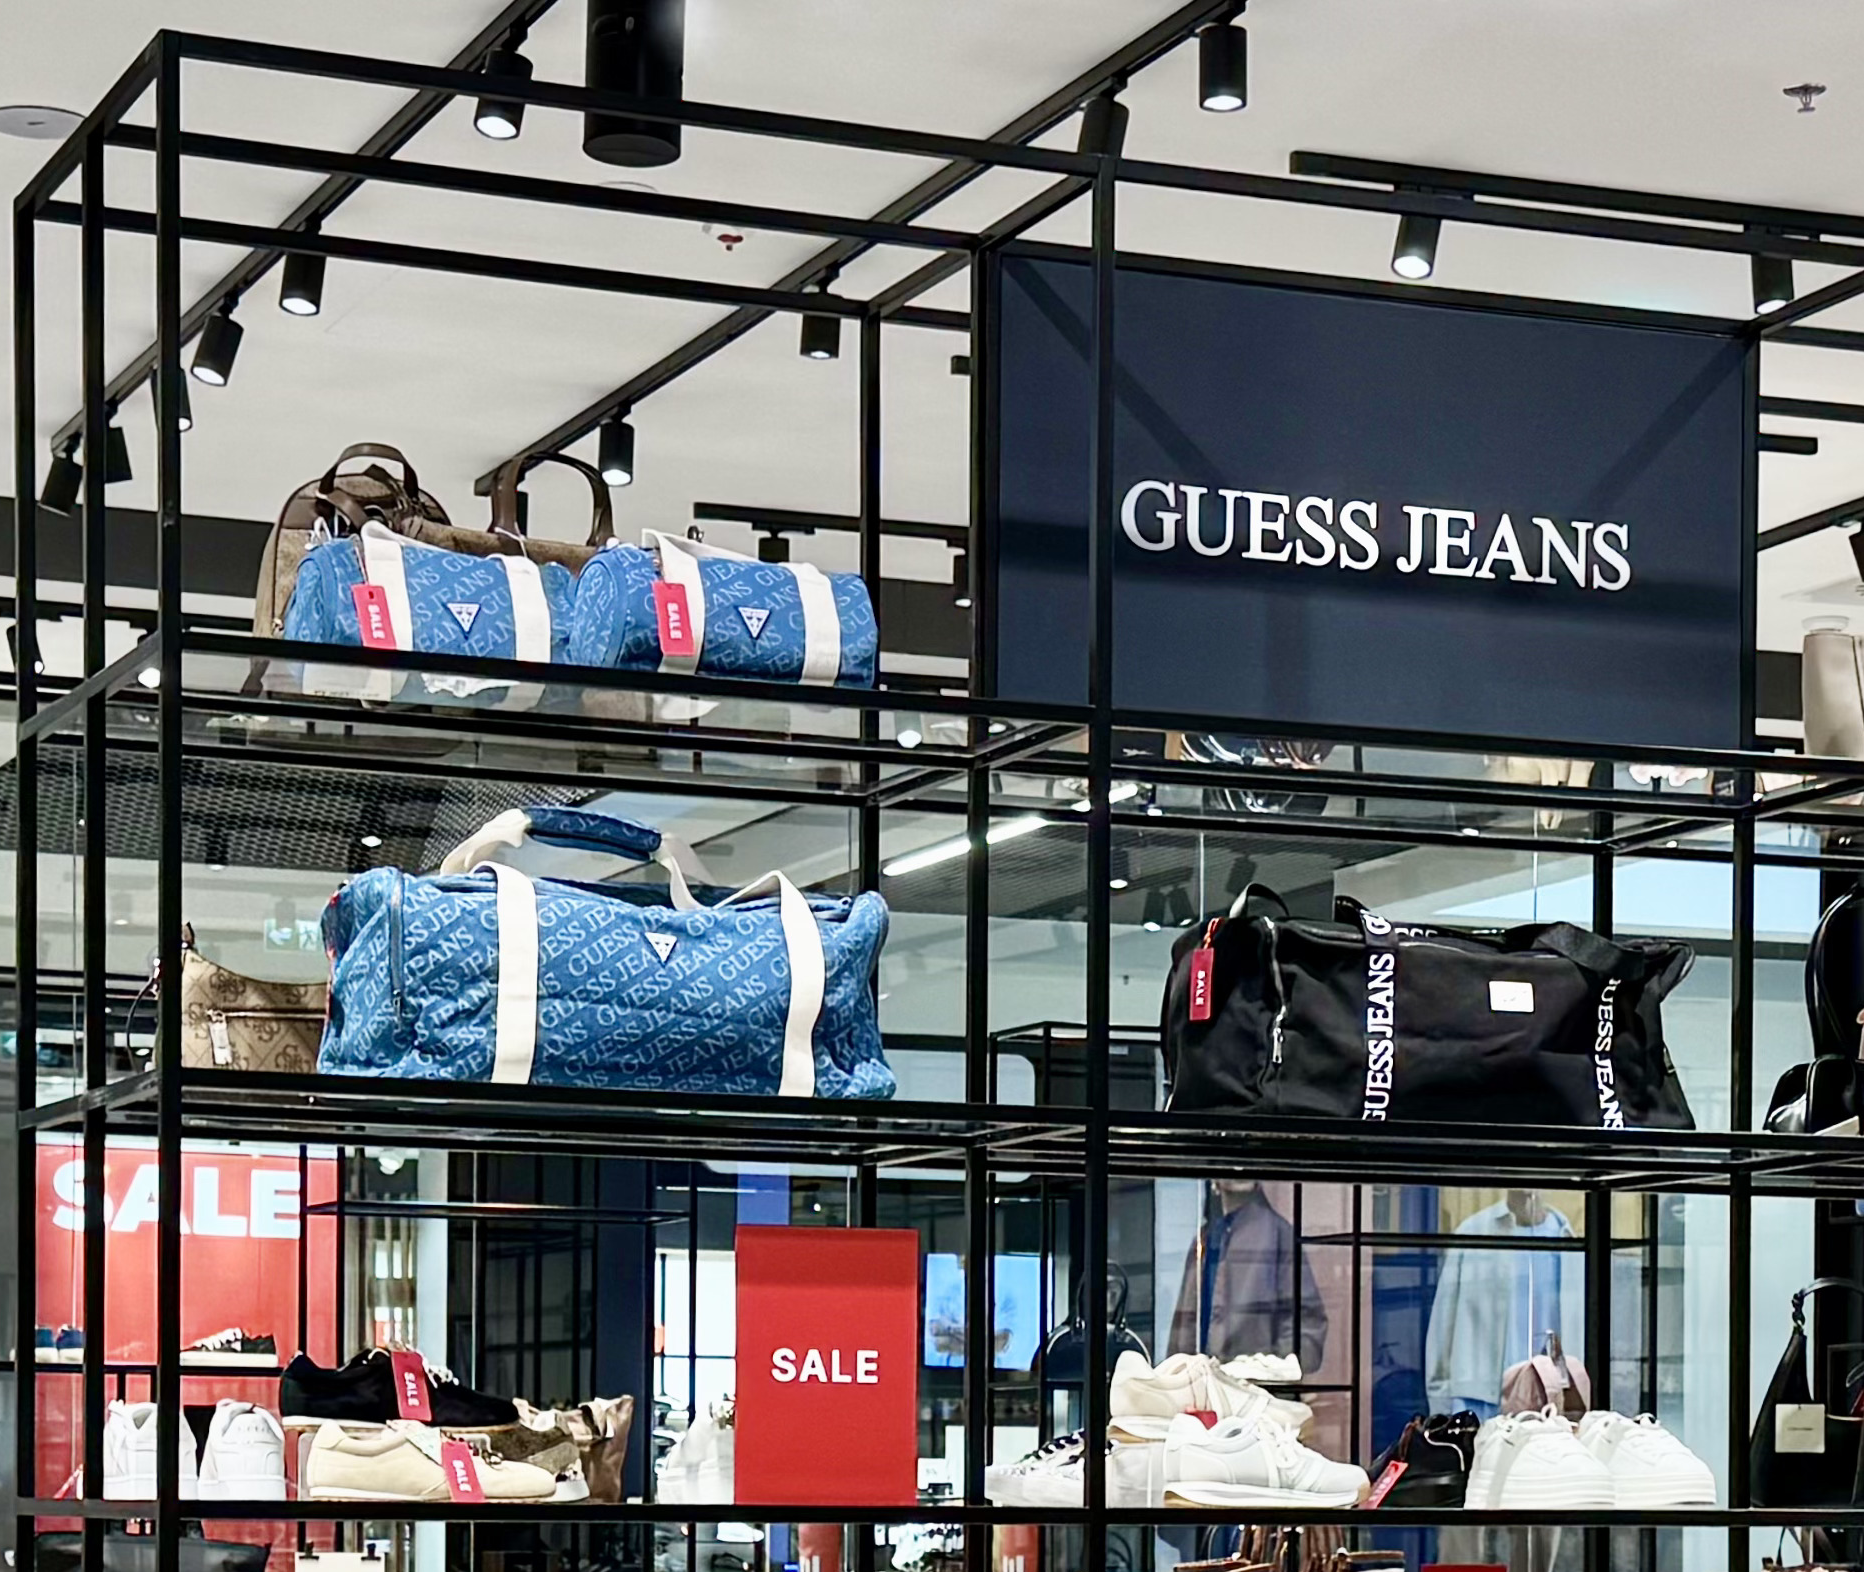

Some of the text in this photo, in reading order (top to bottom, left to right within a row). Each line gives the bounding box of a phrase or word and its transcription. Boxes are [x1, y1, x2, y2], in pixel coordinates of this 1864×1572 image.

[1120, 479, 1632, 591] GUESS JEANS
[368, 604, 386, 640] SALE
[666, 602, 683, 640] SALE
[596, 932, 734, 1027] GUESS JEANS
[718, 928, 784, 982] GUESS
[642, 975, 715, 1033] JEANS
[700, 973, 768, 1031] JEANS
[1196, 969, 1205, 1005] SALE
[1366, 953, 1396, 1039] JEANS
[770, 1348, 879, 1384] SALE
